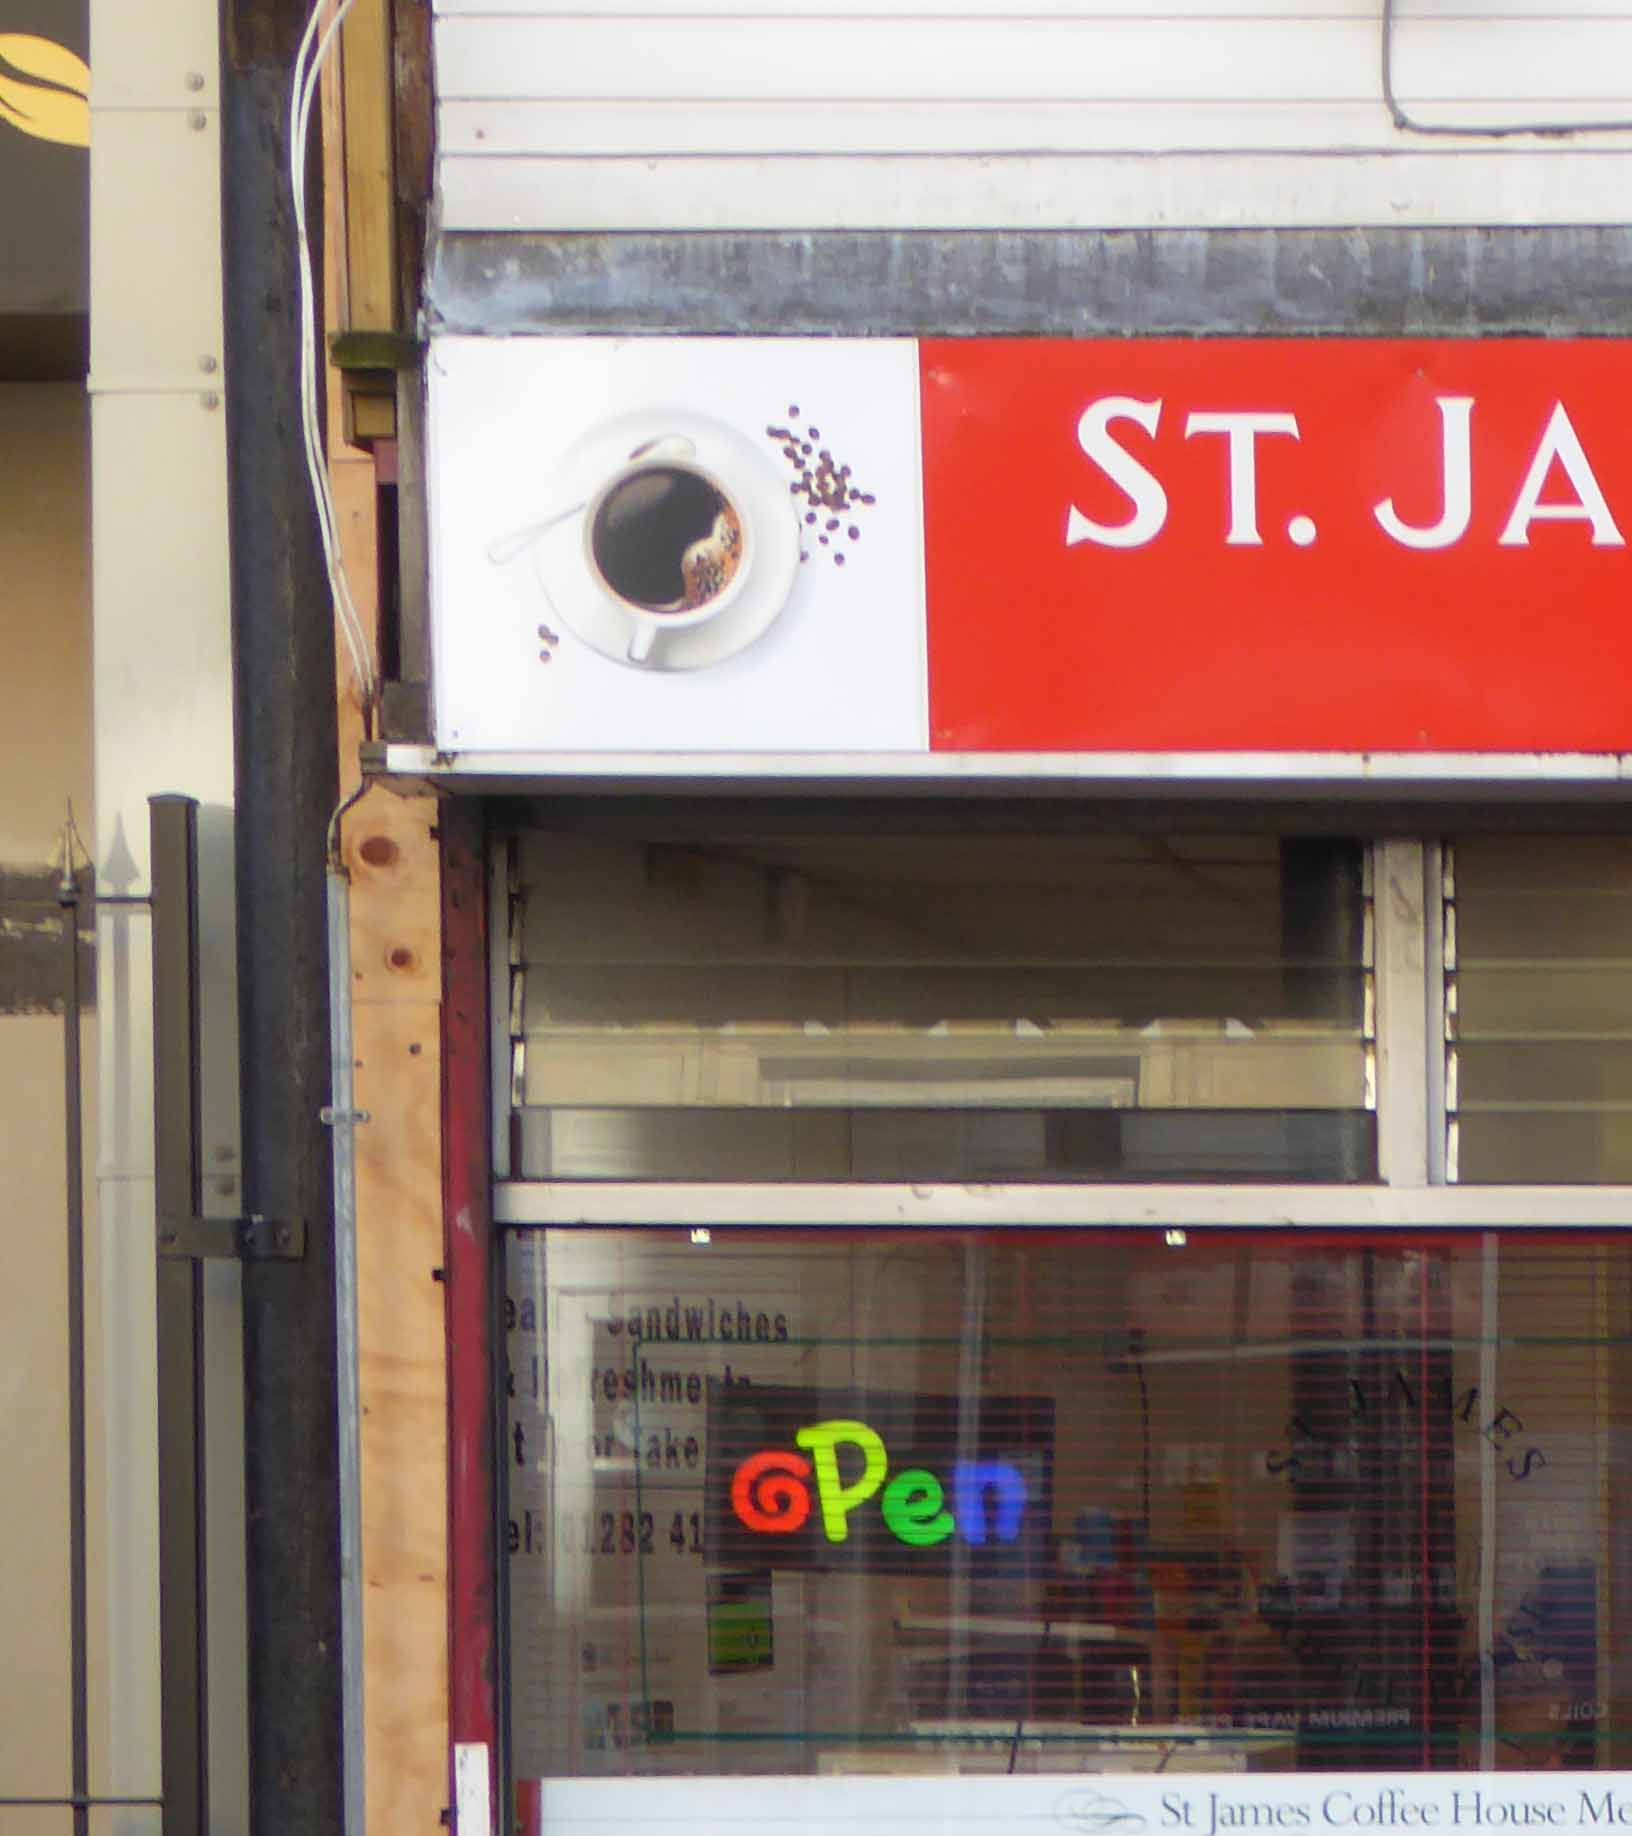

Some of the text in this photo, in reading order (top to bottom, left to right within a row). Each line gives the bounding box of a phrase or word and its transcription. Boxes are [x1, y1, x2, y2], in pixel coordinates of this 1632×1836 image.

[1066, 396, 1318, 548] ST.
[1161, 1793, 1192, 1825] St
[1321, 1790, 1440, 1827] Coffee
[1453, 1793, 1565, 1825] House
